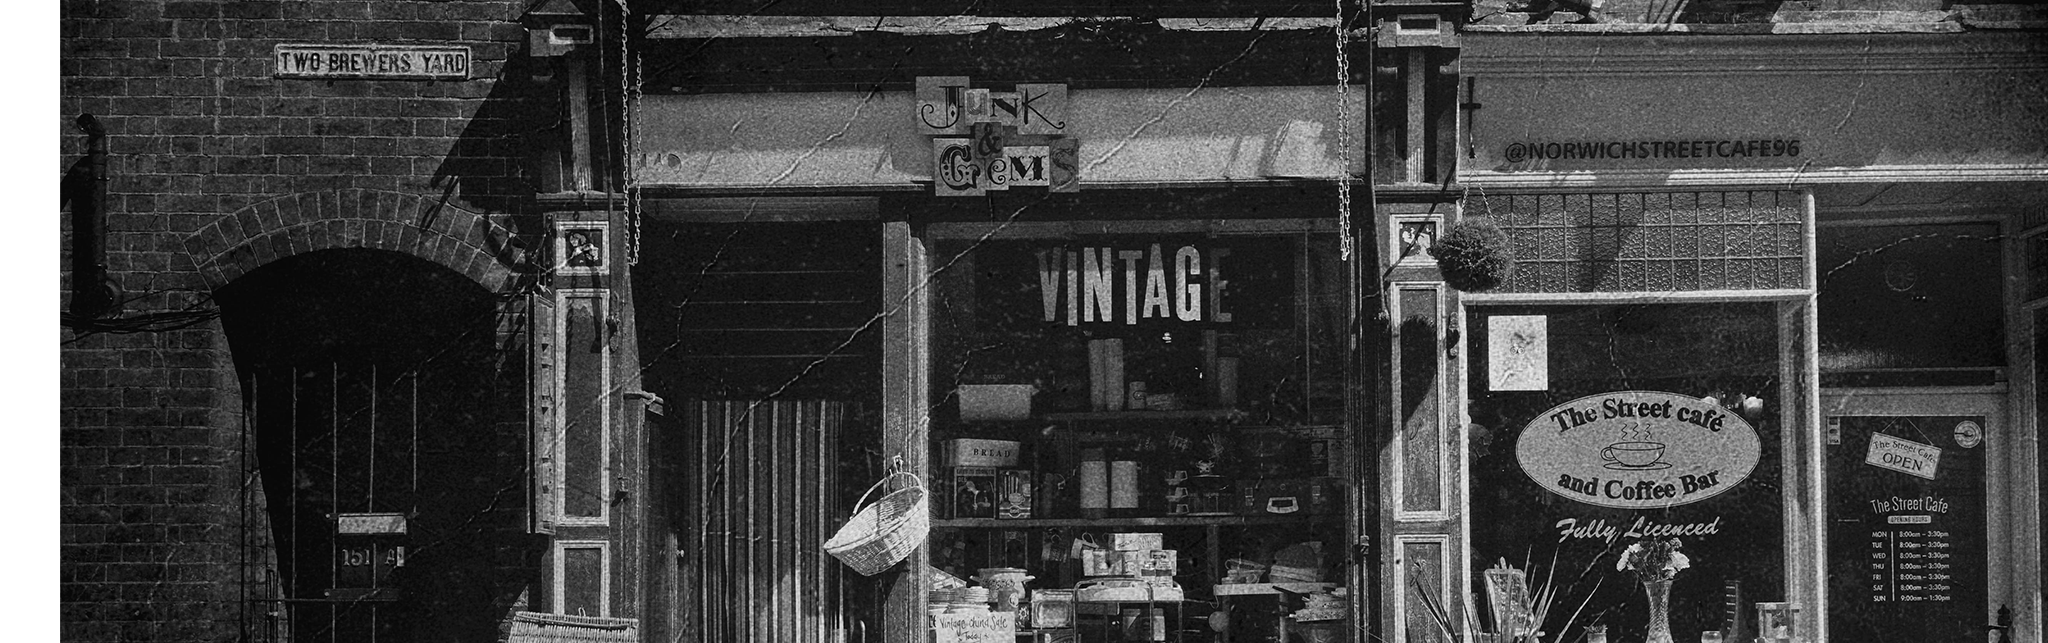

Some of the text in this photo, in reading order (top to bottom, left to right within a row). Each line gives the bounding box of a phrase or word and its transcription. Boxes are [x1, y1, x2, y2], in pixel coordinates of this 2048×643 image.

[280, 52, 465, 73] TWO BREWERS YARD
[977, 122, 1002, 157] &
[1504, 140, 1801, 163] @NORWICHSTREETCAFE96
[1035, 243, 1232, 327] VINTAGE
[1550, 398, 1726, 433] The Street café
[973, 448, 1011, 458] BREAD
[1873, 441, 1890, 449] The
[1892, 441, 1917, 453] Street
[1883, 452, 1923, 472] OPEN
[1557, 469, 1720, 500] and Coffee Bar
[1870, 496, 1949, 514] The Street Cafe
[1555, 516, 1721, 544] Fully Licenced
[1927, 531, 1949, 539] 3:30pm
[1927, 541, 1949, 549] 3:30pm
[342, 549, 395, 566] 151 A
[1928, 552, 1949, 560] 3:30pm
[1928, 563, 1950, 571] 3:30pm
[1928, 584, 1950, 592] 3:30pm
[1929, 595, 1951, 603] 1:30pm
[939, 616, 966, 637] Vintage
[990, 615, 1008, 631] Sale
